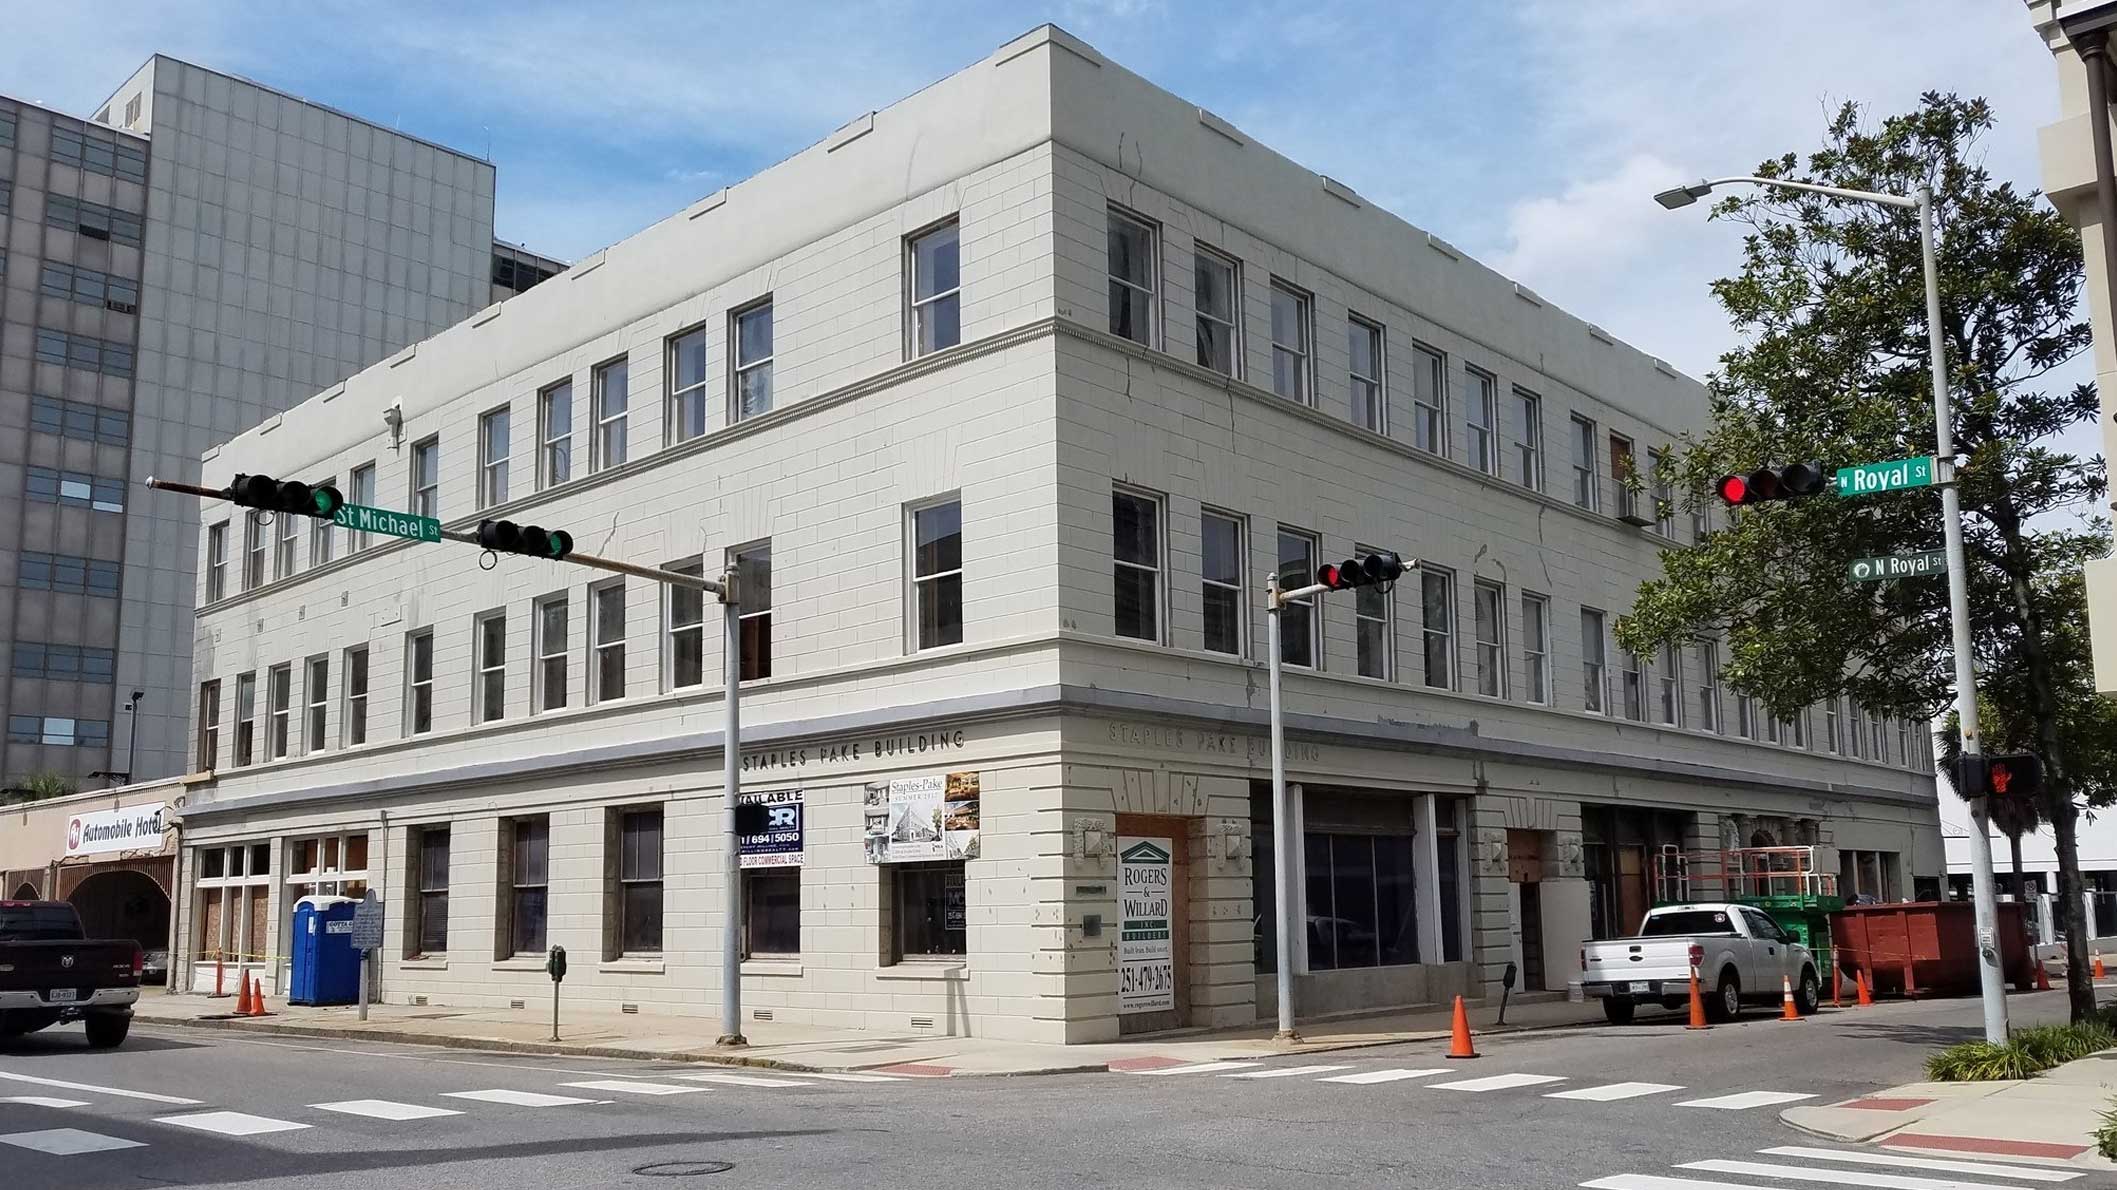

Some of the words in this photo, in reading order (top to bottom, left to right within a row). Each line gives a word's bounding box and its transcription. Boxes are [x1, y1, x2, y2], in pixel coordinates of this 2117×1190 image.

[1840, 476, 1848, 488] N
[1854, 463, 1908, 491] Royal
[1915, 465, 1926, 478] St
[337, 506, 354, 526] St
[360, 508, 423, 538] Michael
[429, 525, 438, 536] St
[1875, 559, 1885, 576] N
[1891, 555, 1930, 576] Royal
[1933, 557, 1942, 566] St
[743, 749, 806, 772] STAPLES
[820, 743, 860, 764] PAKE
[875, 730, 964, 758] BUILDING
[1108, 720, 1184, 749] STAPLES
[1197, 731, 1237, 754] PAKE
[1246, 735, 1320, 762] BUDING
[891, 778, 943, 794] Staples-Pake
[83, 818, 133, 844] Automobile
[135, 814, 161, 838] Hotel
[1124, 867, 1168, 886] ROGERS
[1143, 886, 1150, 897] &
[1124, 899, 1168, 918] WILLARD
